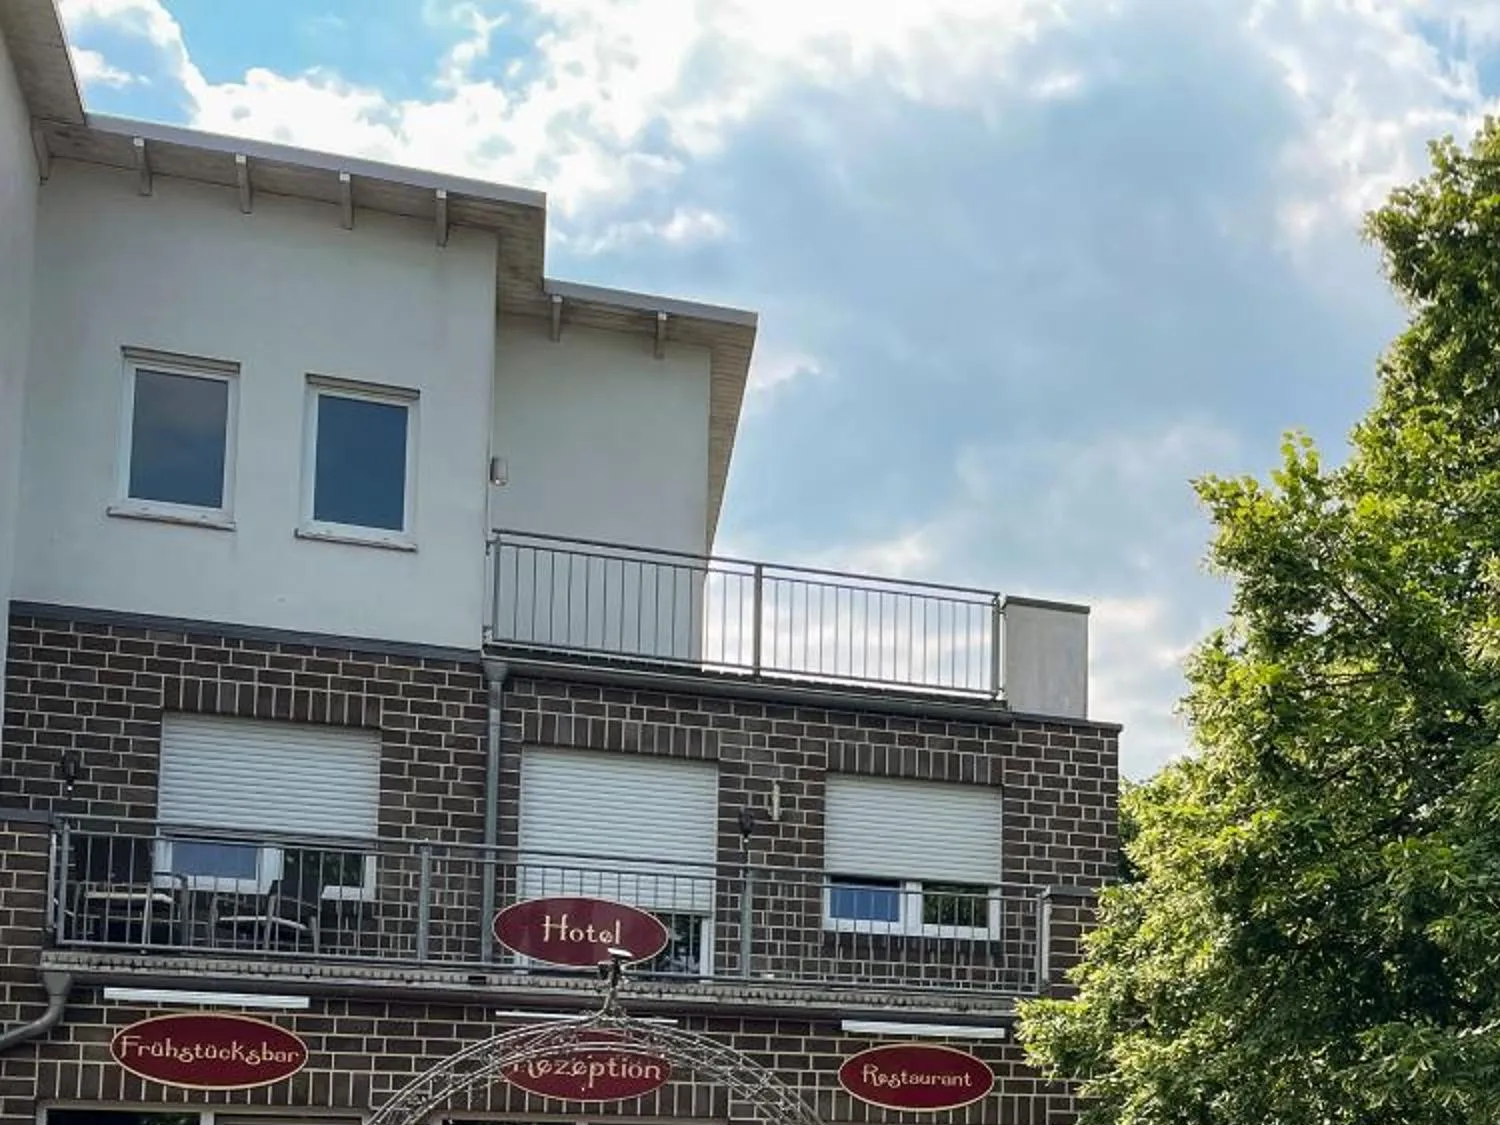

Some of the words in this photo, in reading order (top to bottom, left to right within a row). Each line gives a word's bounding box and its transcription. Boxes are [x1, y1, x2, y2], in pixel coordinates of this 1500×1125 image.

[541, 913, 621, 945] Hotel
[120, 1035, 300, 1066] Frühstücksbar
[862, 1063, 973, 1089] Restaurant
